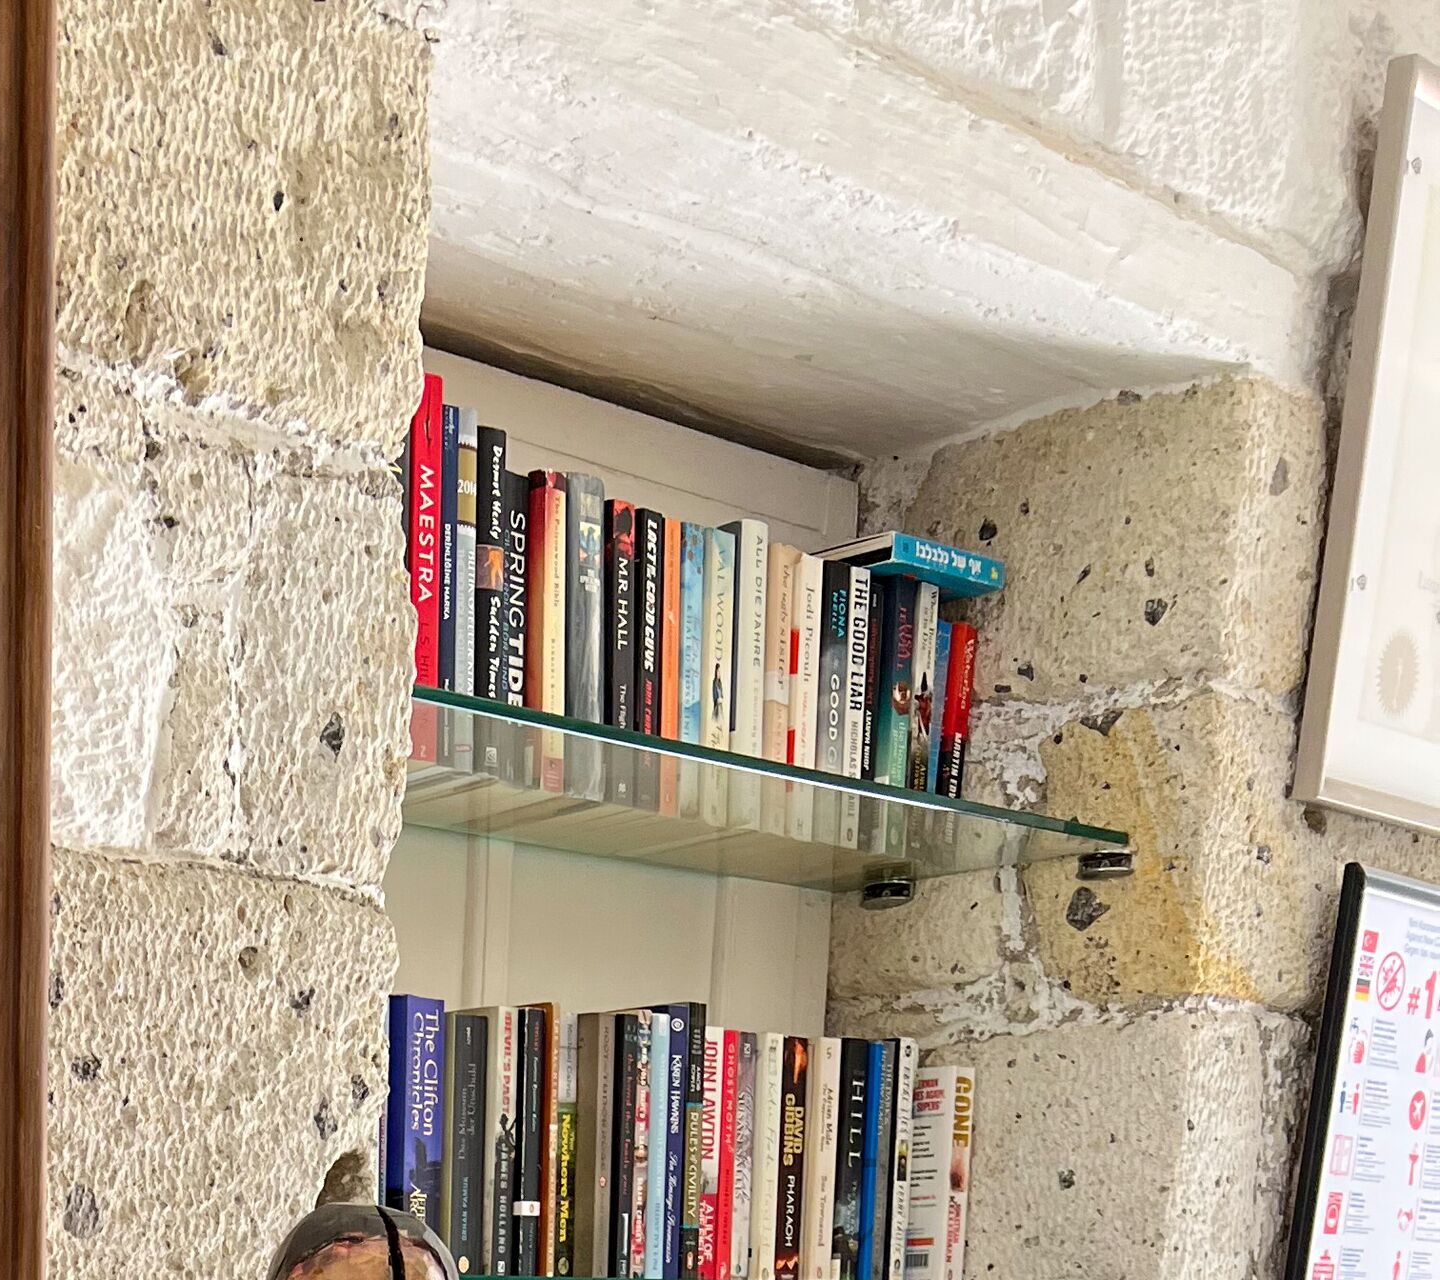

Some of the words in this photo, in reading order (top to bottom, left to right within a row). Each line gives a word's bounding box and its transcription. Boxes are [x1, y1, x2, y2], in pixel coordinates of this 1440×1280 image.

[492, 445, 503, 498] Dermot
[418, 464, 435, 602] MAESTRA
[490, 500, 502, 540] Healy
[646, 519, 658, 566] LAST
[443, 523, 452, 585] DERİNLİĞİNE
[509, 510, 526, 629] SPRING
[754, 535, 763, 569] ALL
[618, 557, 630, 595] M.R.
[754, 576, 763, 605] DIE
[854, 577, 869, 612] THE
[442, 585, 451, 620] MARKA
[488, 595, 501, 652] Sudden
[805, 583, 815, 619] Jodi
[831, 591, 839, 632] NEILL
[838, 589, 848, 638] FIONA
[616, 600, 629, 650] HALL
[714, 591, 726, 664] WOOD
[752, 611, 762, 667] JAHRE
[851, 616, 867, 667] GOOD
[643, 626, 655, 673] GUYS
[802, 626, 814, 683] Picoult
[487, 656, 500, 700] Times
[619, 683, 628, 704] The
[848, 669, 865, 712] LIAR
[618, 705, 627, 729] Fligh
[828, 673, 840, 741] GOOD
[864, 709, 873, 745] HARVEY
[849, 720, 858, 771] NICHOLAS
[863, 744, 871, 771] JOHN
[950, 731, 963, 778] MARTIN
[425, 1008, 440, 1053] The
[411, 1011, 425, 1131] Chronicles
[671, 1054, 682, 1088] KAREN
[704, 1040, 718, 1083] JOHN
[726, 1043, 736, 1095] GHOST
[423, 1058, 439, 1136] Clifton
[502, 1074, 512, 1115] PACT
[670, 1090, 681, 1134] HAWKINS
[735, 1090, 746, 1145] SUSAN
[825, 1088, 834, 1121] Adrian
[953, 1076, 973, 1148] GONE
[688, 1112, 699, 1153] RULES
[701, 1087, 716, 1160] LAWTON
[724, 1099, 734, 1144] MOTH
[783, 1093, 796, 1166] GIBBINS
[793, 1106, 804, 1154] DAVID
[847, 1078, 865, 1168] HILL
[499, 1143, 509, 1189] JAMES
[559, 1113, 572, 1197] Nowhere
[686, 1165, 697, 1218] CIVILITY
[784, 1174, 796, 1247] PHARAOH
[498, 1195, 508, 1254] HOLLAND
[558, 1198, 570, 1243] Men
[817, 1194, 827, 1247] Townsend
[703, 1239, 713, 1262] OF
